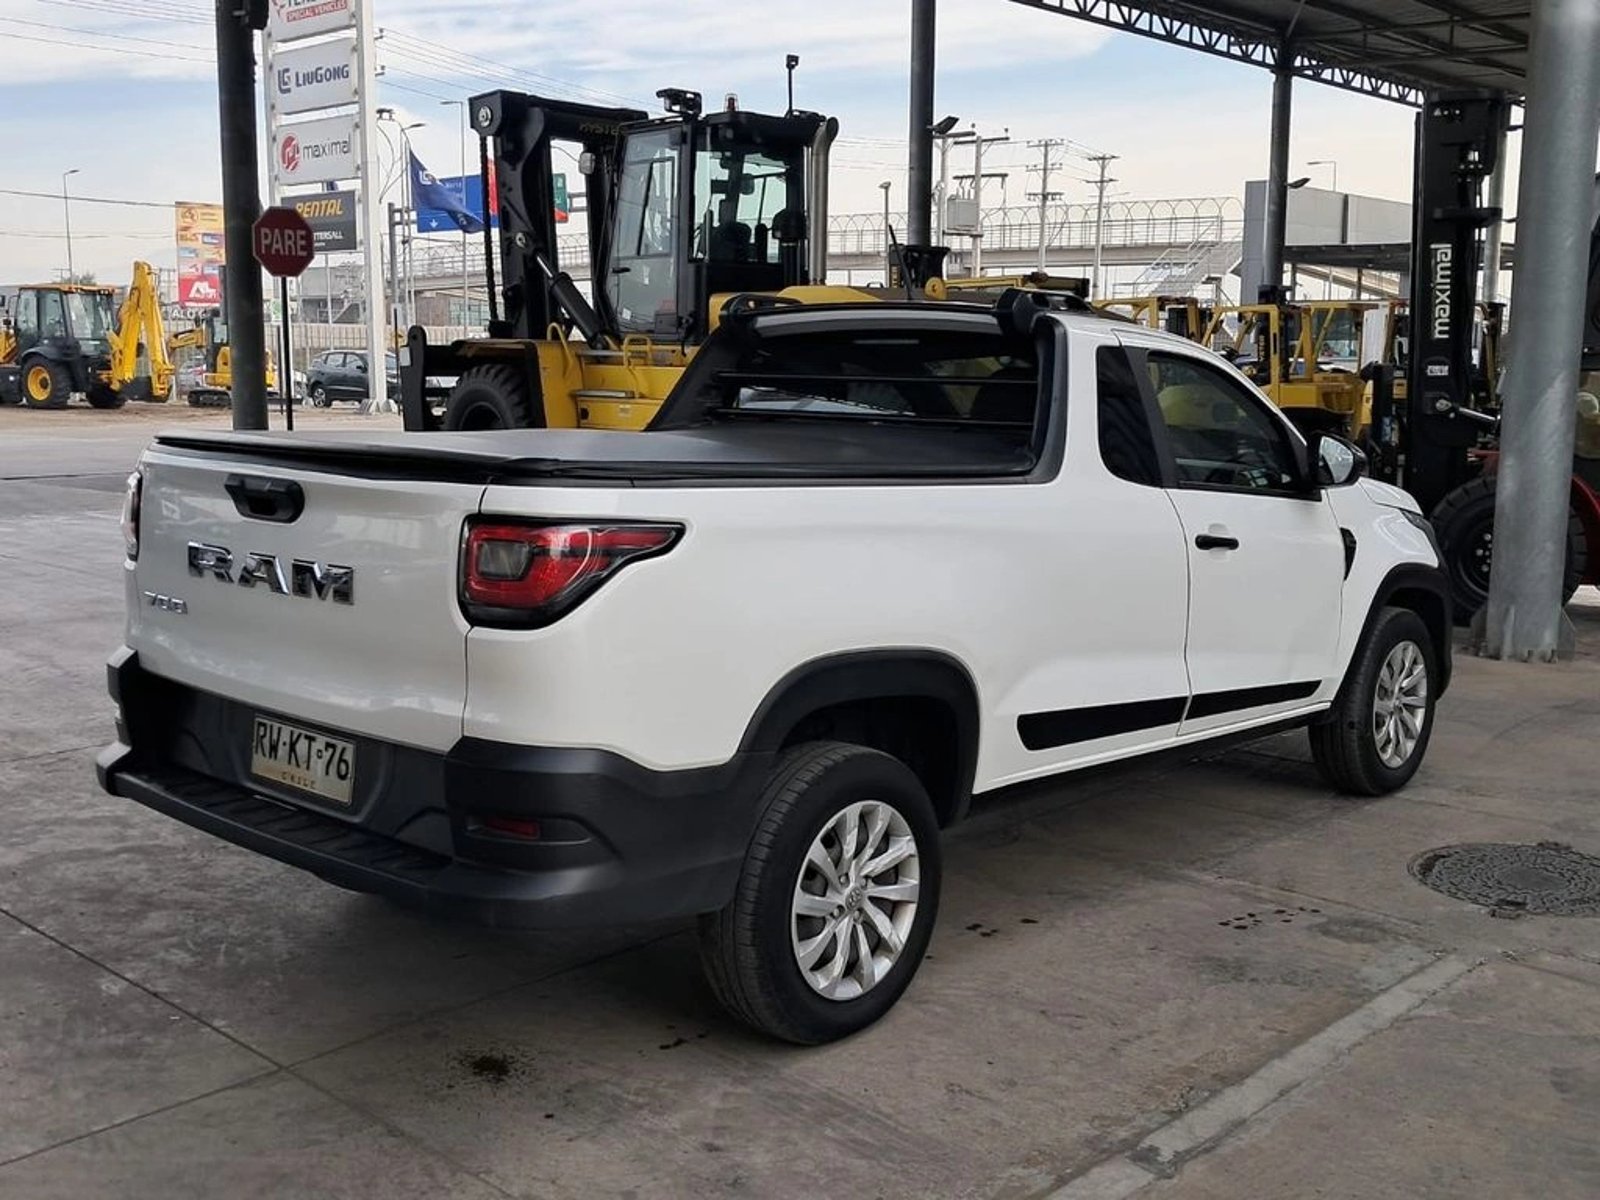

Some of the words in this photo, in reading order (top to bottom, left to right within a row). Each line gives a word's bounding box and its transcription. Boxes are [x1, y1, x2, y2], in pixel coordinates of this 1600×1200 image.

[303, 132, 351, 160] maximal
[296, 199, 344, 218] RENTAL
[261, 228, 308, 257] PARE
[1430, 243, 1452, 339] maximal
[187, 540, 354, 606] RAM
